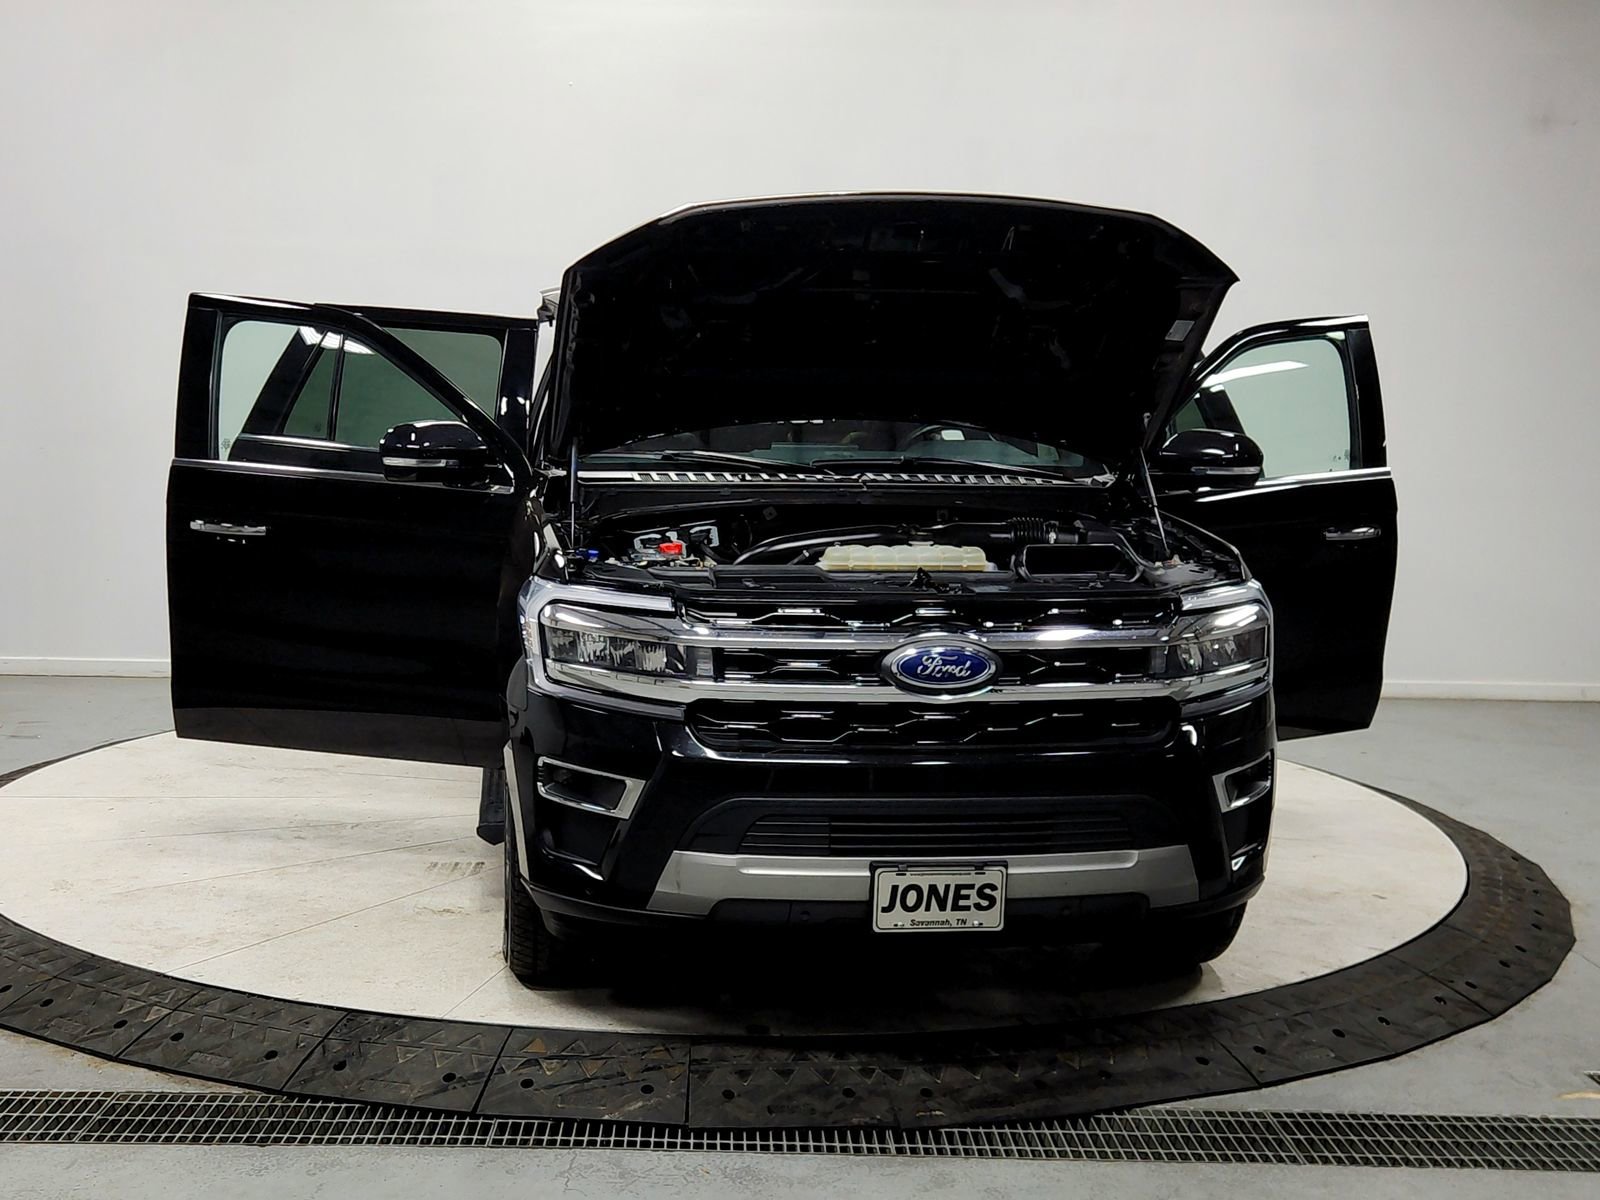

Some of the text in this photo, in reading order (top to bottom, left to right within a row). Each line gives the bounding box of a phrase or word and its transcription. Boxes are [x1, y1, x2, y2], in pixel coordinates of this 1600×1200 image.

[917, 653, 971, 677] Ford
[880, 883, 999, 913] JONES
[910, 918, 968, 927] Savannah, TN
